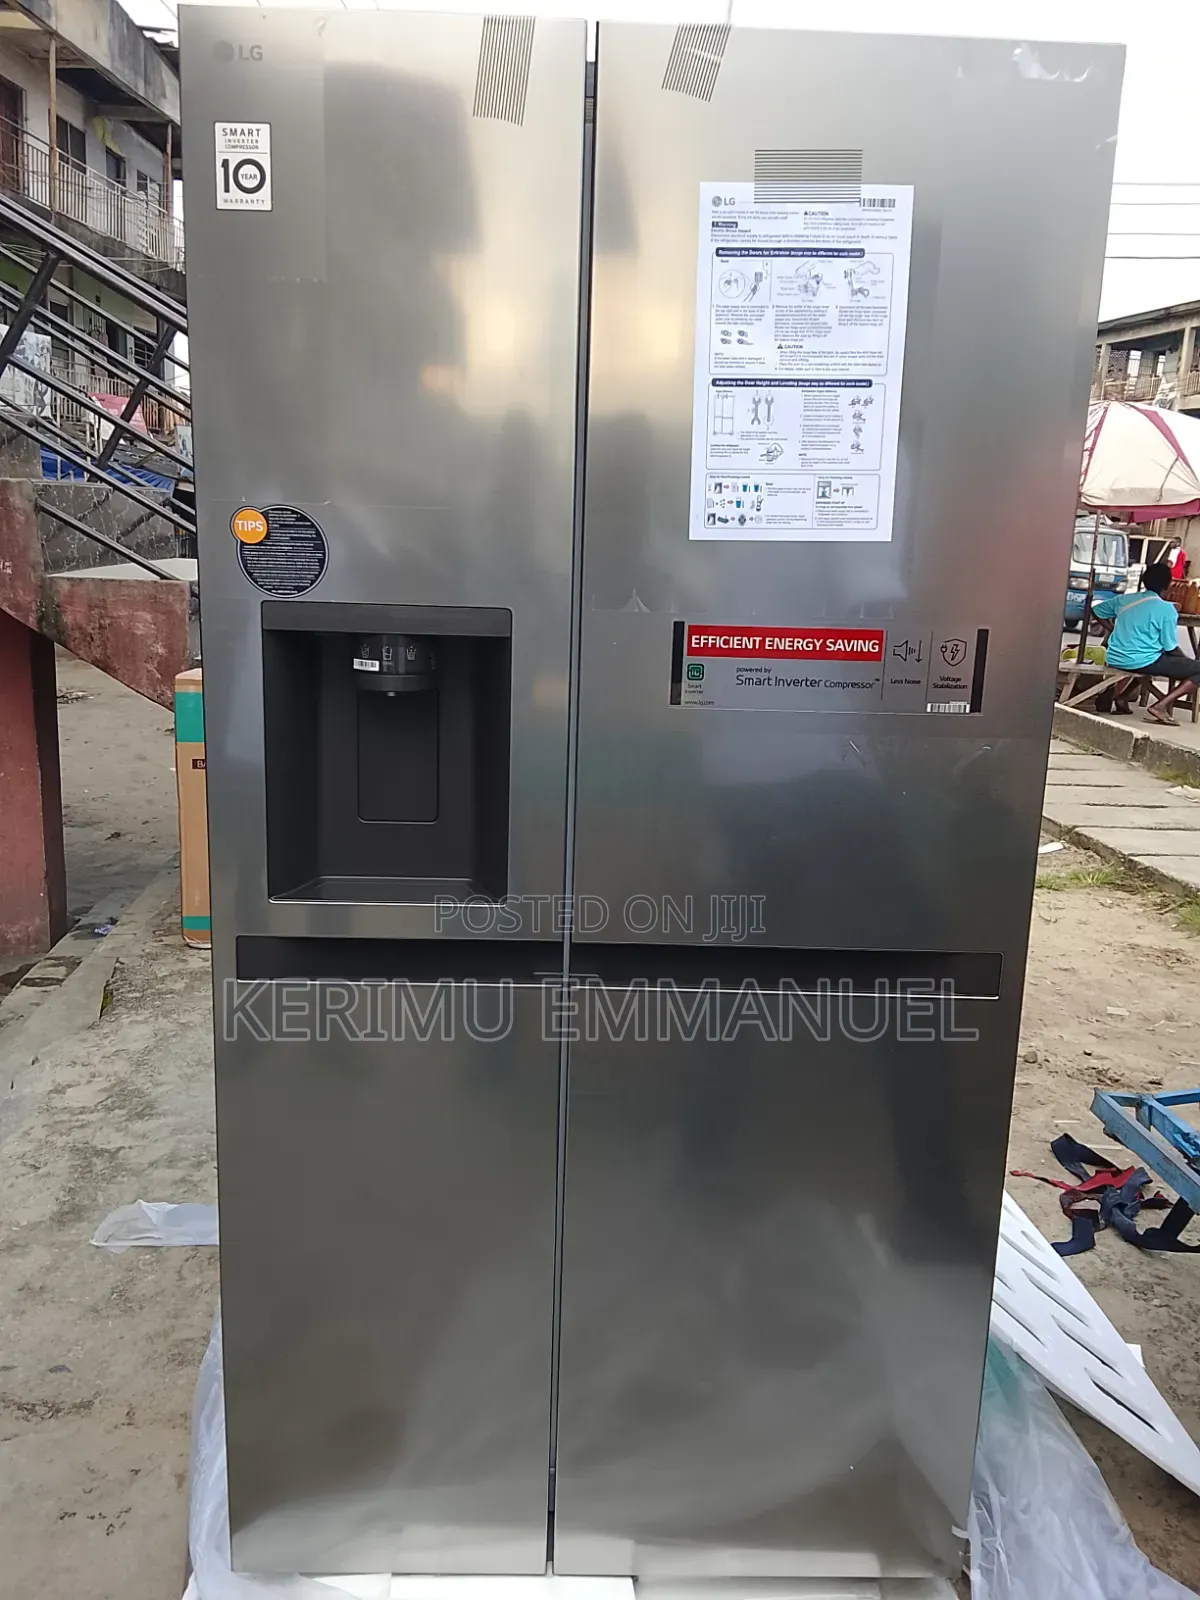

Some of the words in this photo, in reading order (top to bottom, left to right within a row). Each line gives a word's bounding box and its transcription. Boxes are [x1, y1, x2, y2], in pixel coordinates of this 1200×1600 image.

[238, 44, 264, 61] LG
[222, 128, 261, 137] SMART
[221, 158, 266, 194] 10
[723, 197, 736, 206] LG
[236, 520, 264, 532] TIPS
[691, 635, 762, 649] EFFICIENT
[765, 637, 823, 651] ENERGY
[825, 638, 879, 653] SAVING
[736, 674, 773, 687] Smart
[774, 676, 823, 688] Inverter
